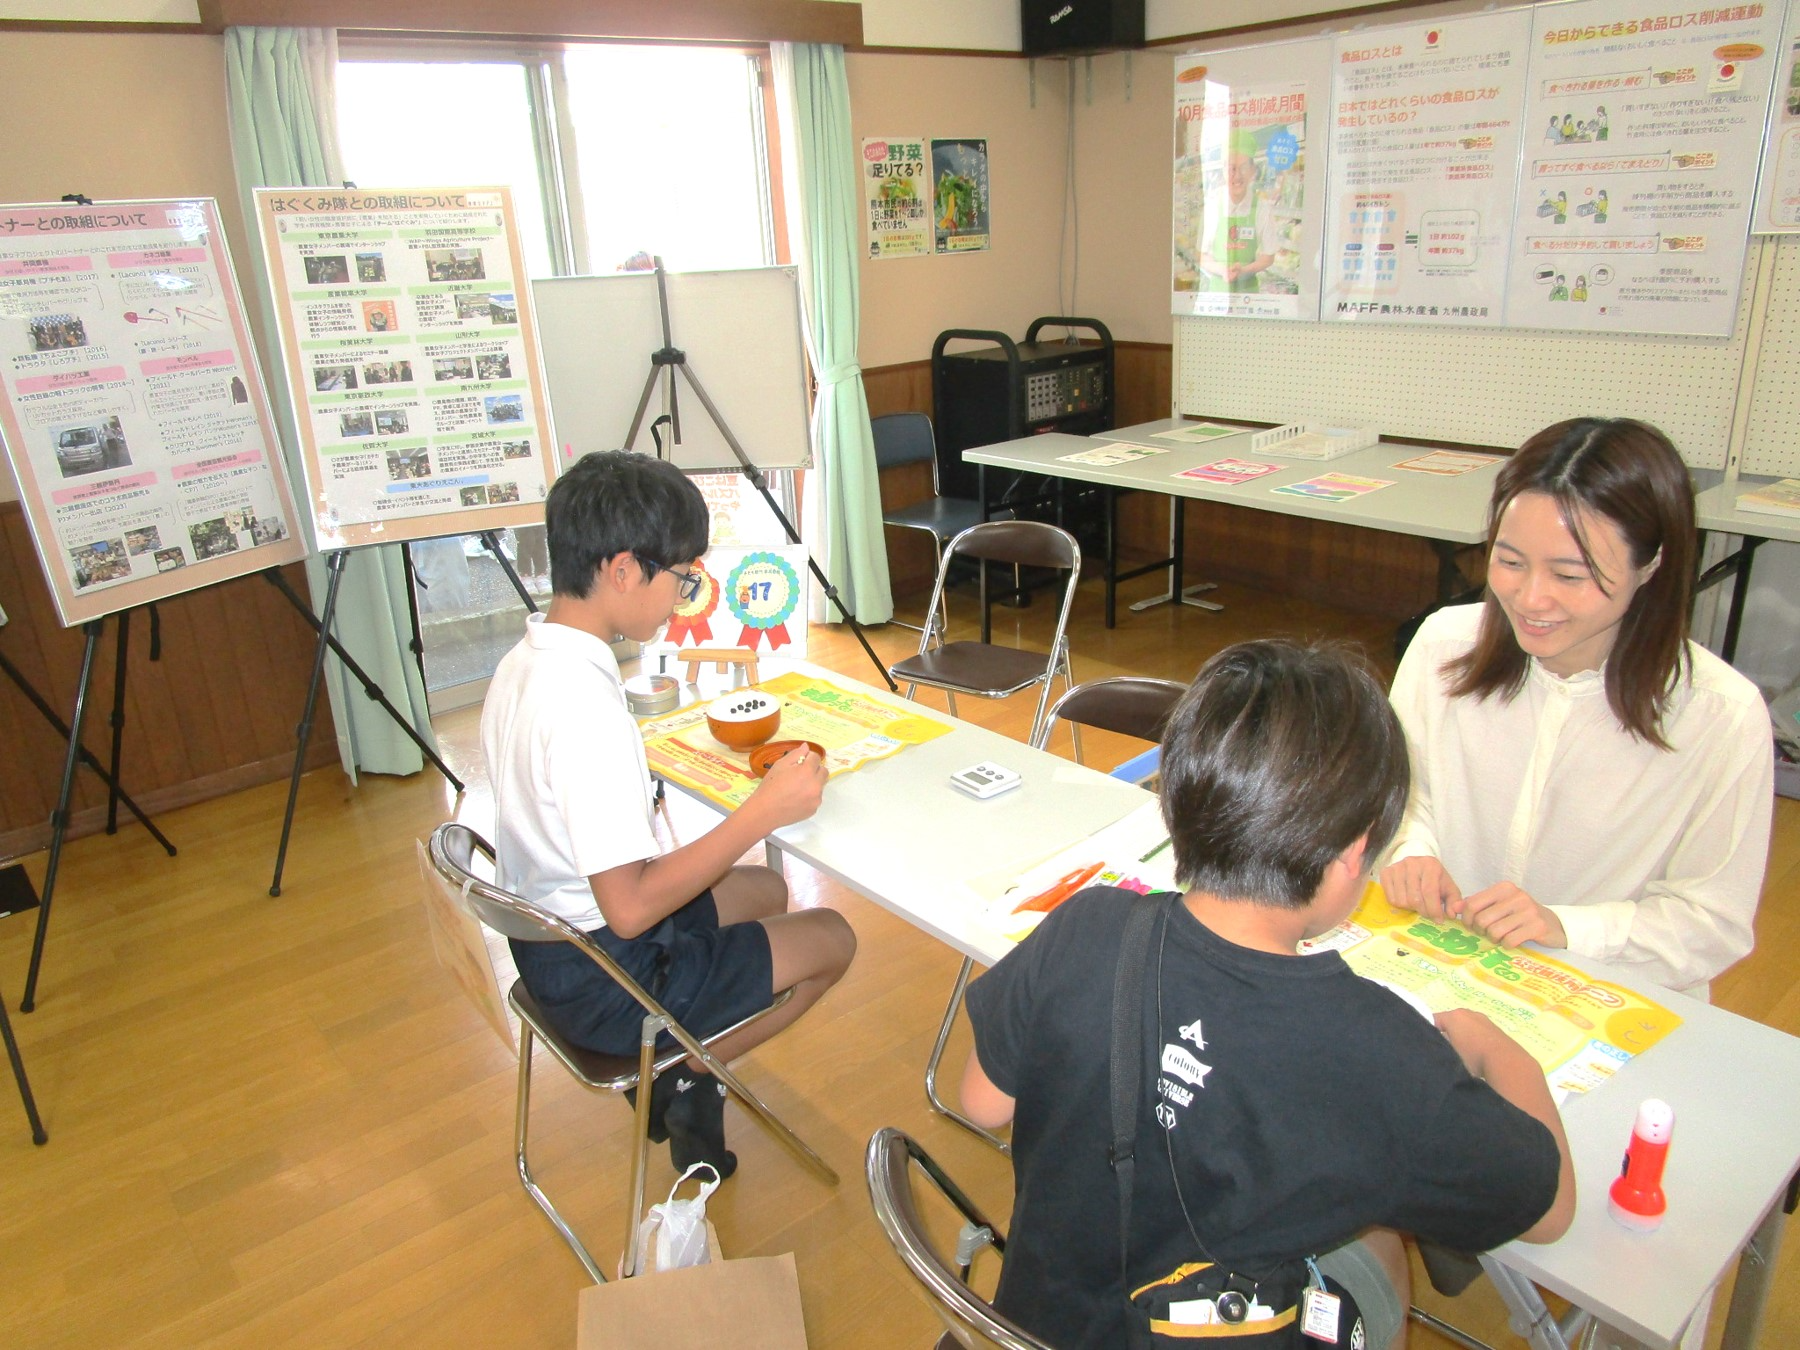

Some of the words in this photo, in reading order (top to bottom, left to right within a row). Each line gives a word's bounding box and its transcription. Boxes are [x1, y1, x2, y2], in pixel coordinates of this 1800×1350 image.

[1543, 3, 1763, 44] 今日からできる食品ロス削減運動
[1341, 46, 1403, 63] 食品ロスとは
[1339, 88, 1499, 113] 日本ではどれくらいの食品ロスが
[888, 144, 922, 161] 野菜
[271, 195, 464, 212] はぐくみ隊との取組について
[872, 220, 908, 231] 食べていません
[1532, 239, 1655, 250] 食べる分だけ予約して買いましょう
[1337, 302, 1378, 314] MAFF
[1380, 305, 1439, 315] 農林水産省
[1443, 306, 1488, 317] 九州農政局
[461, 383, 492, 391] 南九州大学
[472, 431, 496, 439] 宮城大学
[749, 582, 772, 601] 17
